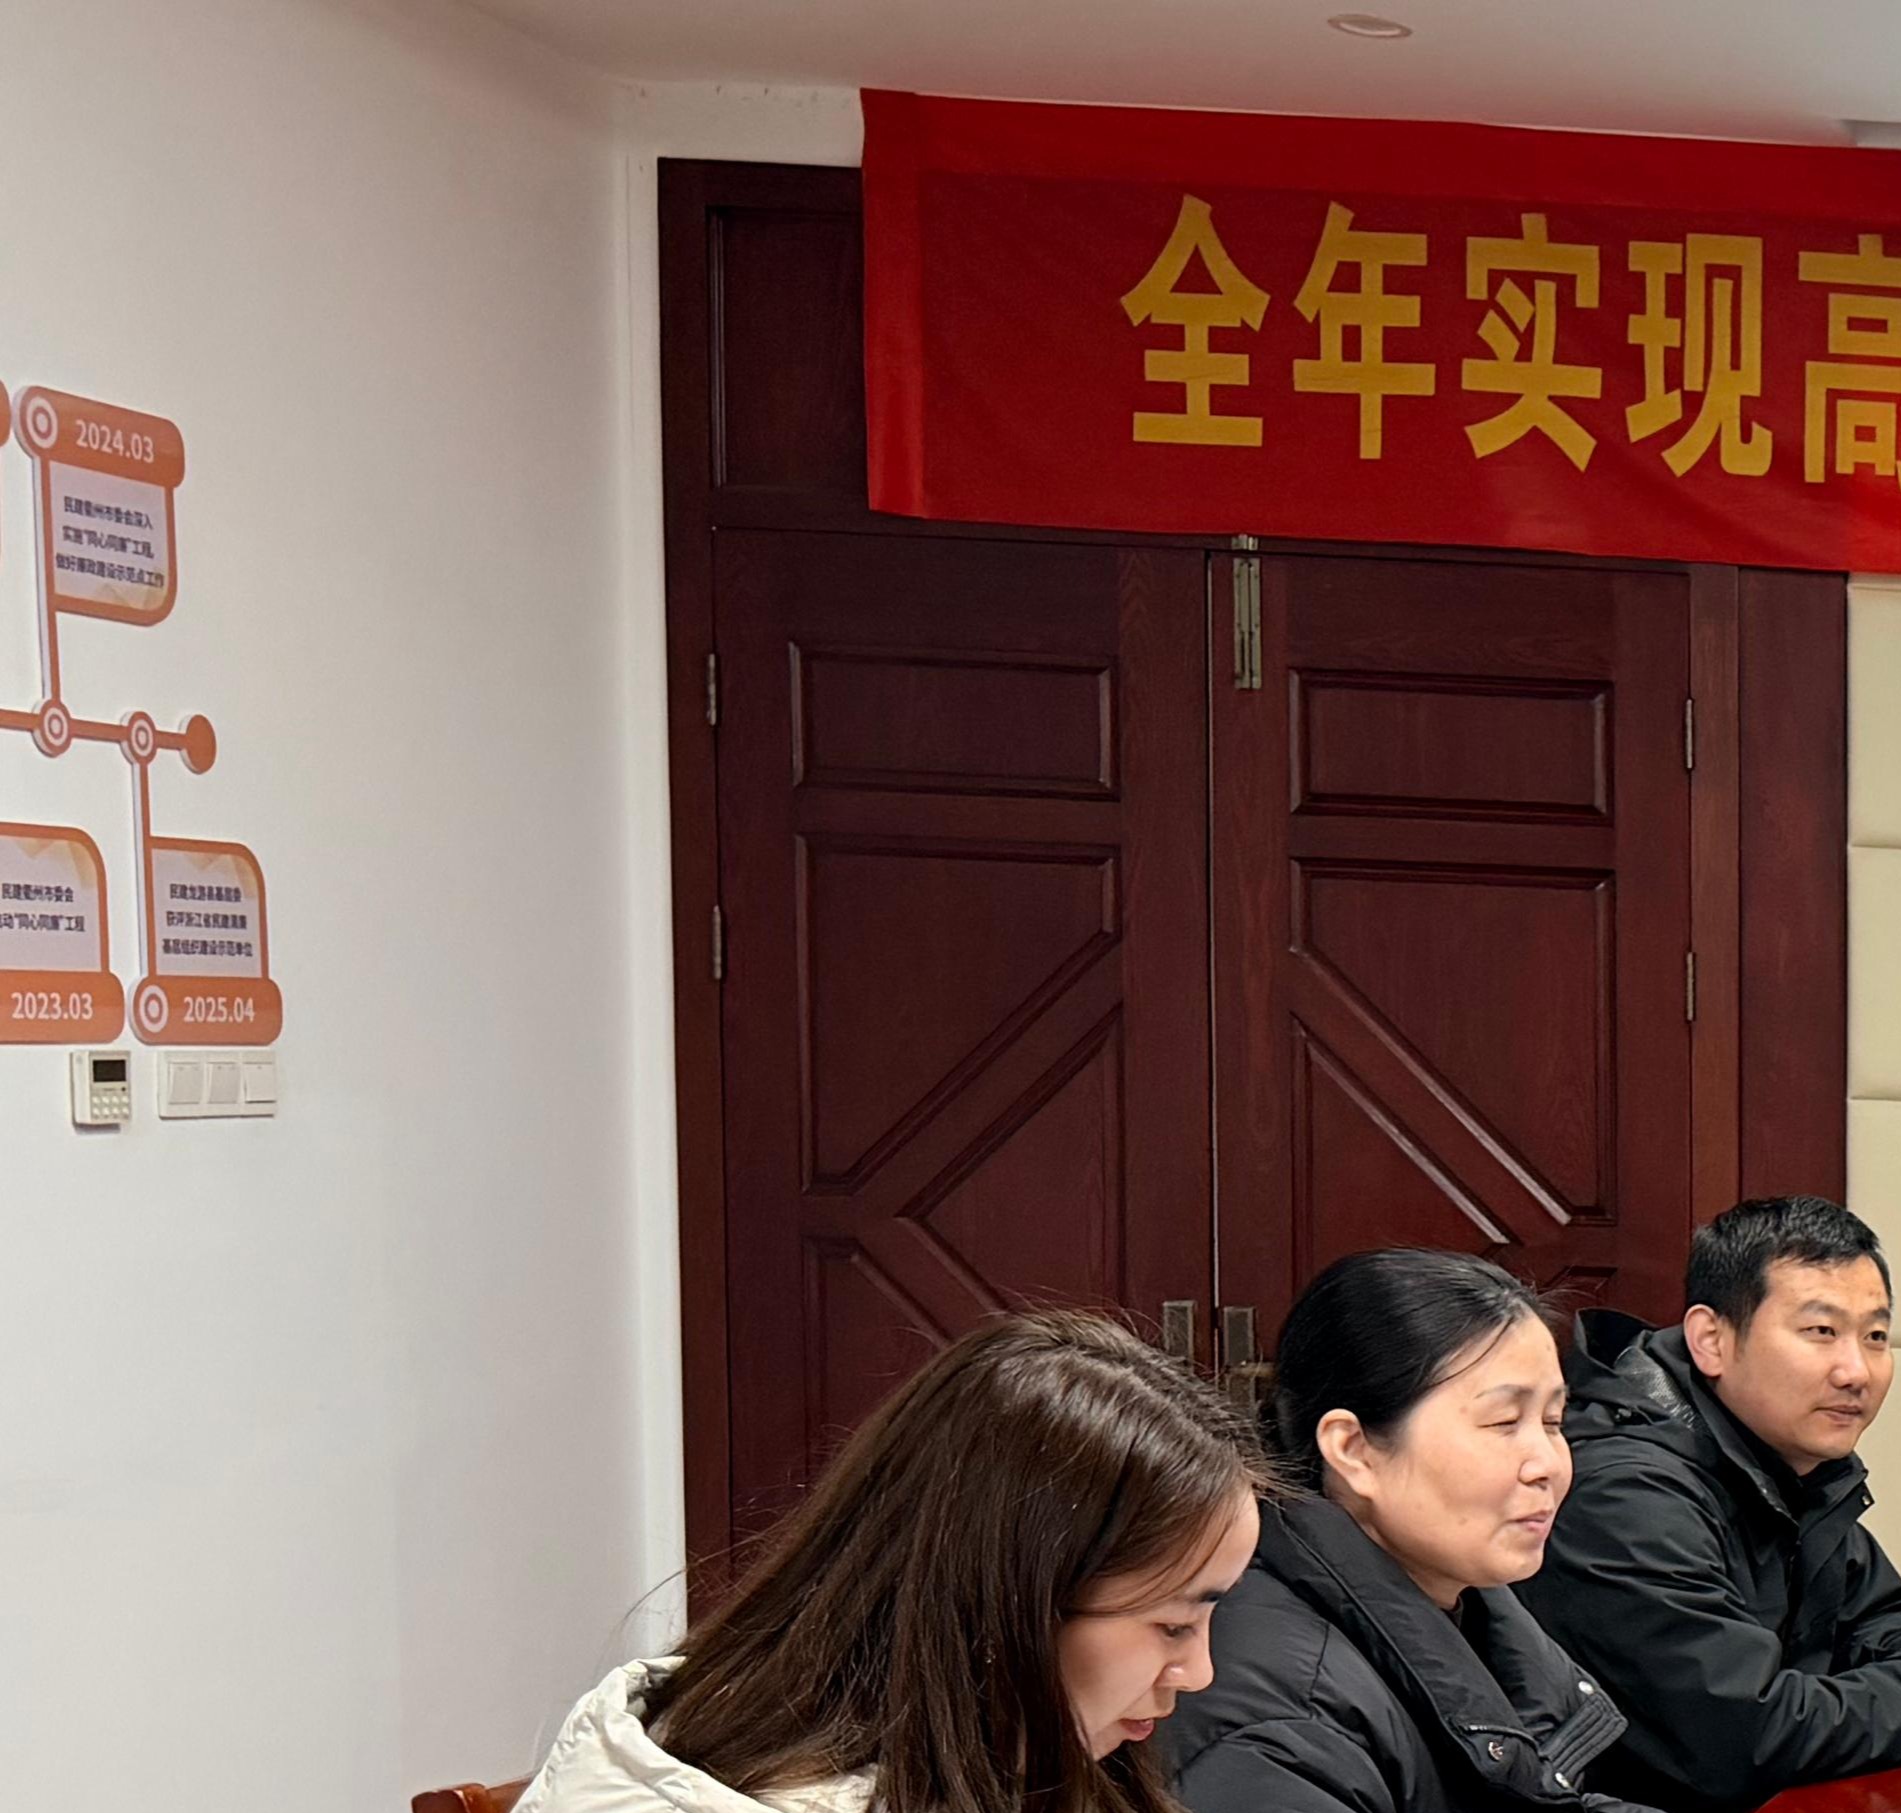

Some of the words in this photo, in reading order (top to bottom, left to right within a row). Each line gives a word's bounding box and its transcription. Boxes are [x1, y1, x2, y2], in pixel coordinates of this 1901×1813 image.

[75, 419, 154, 464] 2024.03
[11, 992, 94, 1020] 2023.03
[183, 996, 256, 1023] 2025.04
